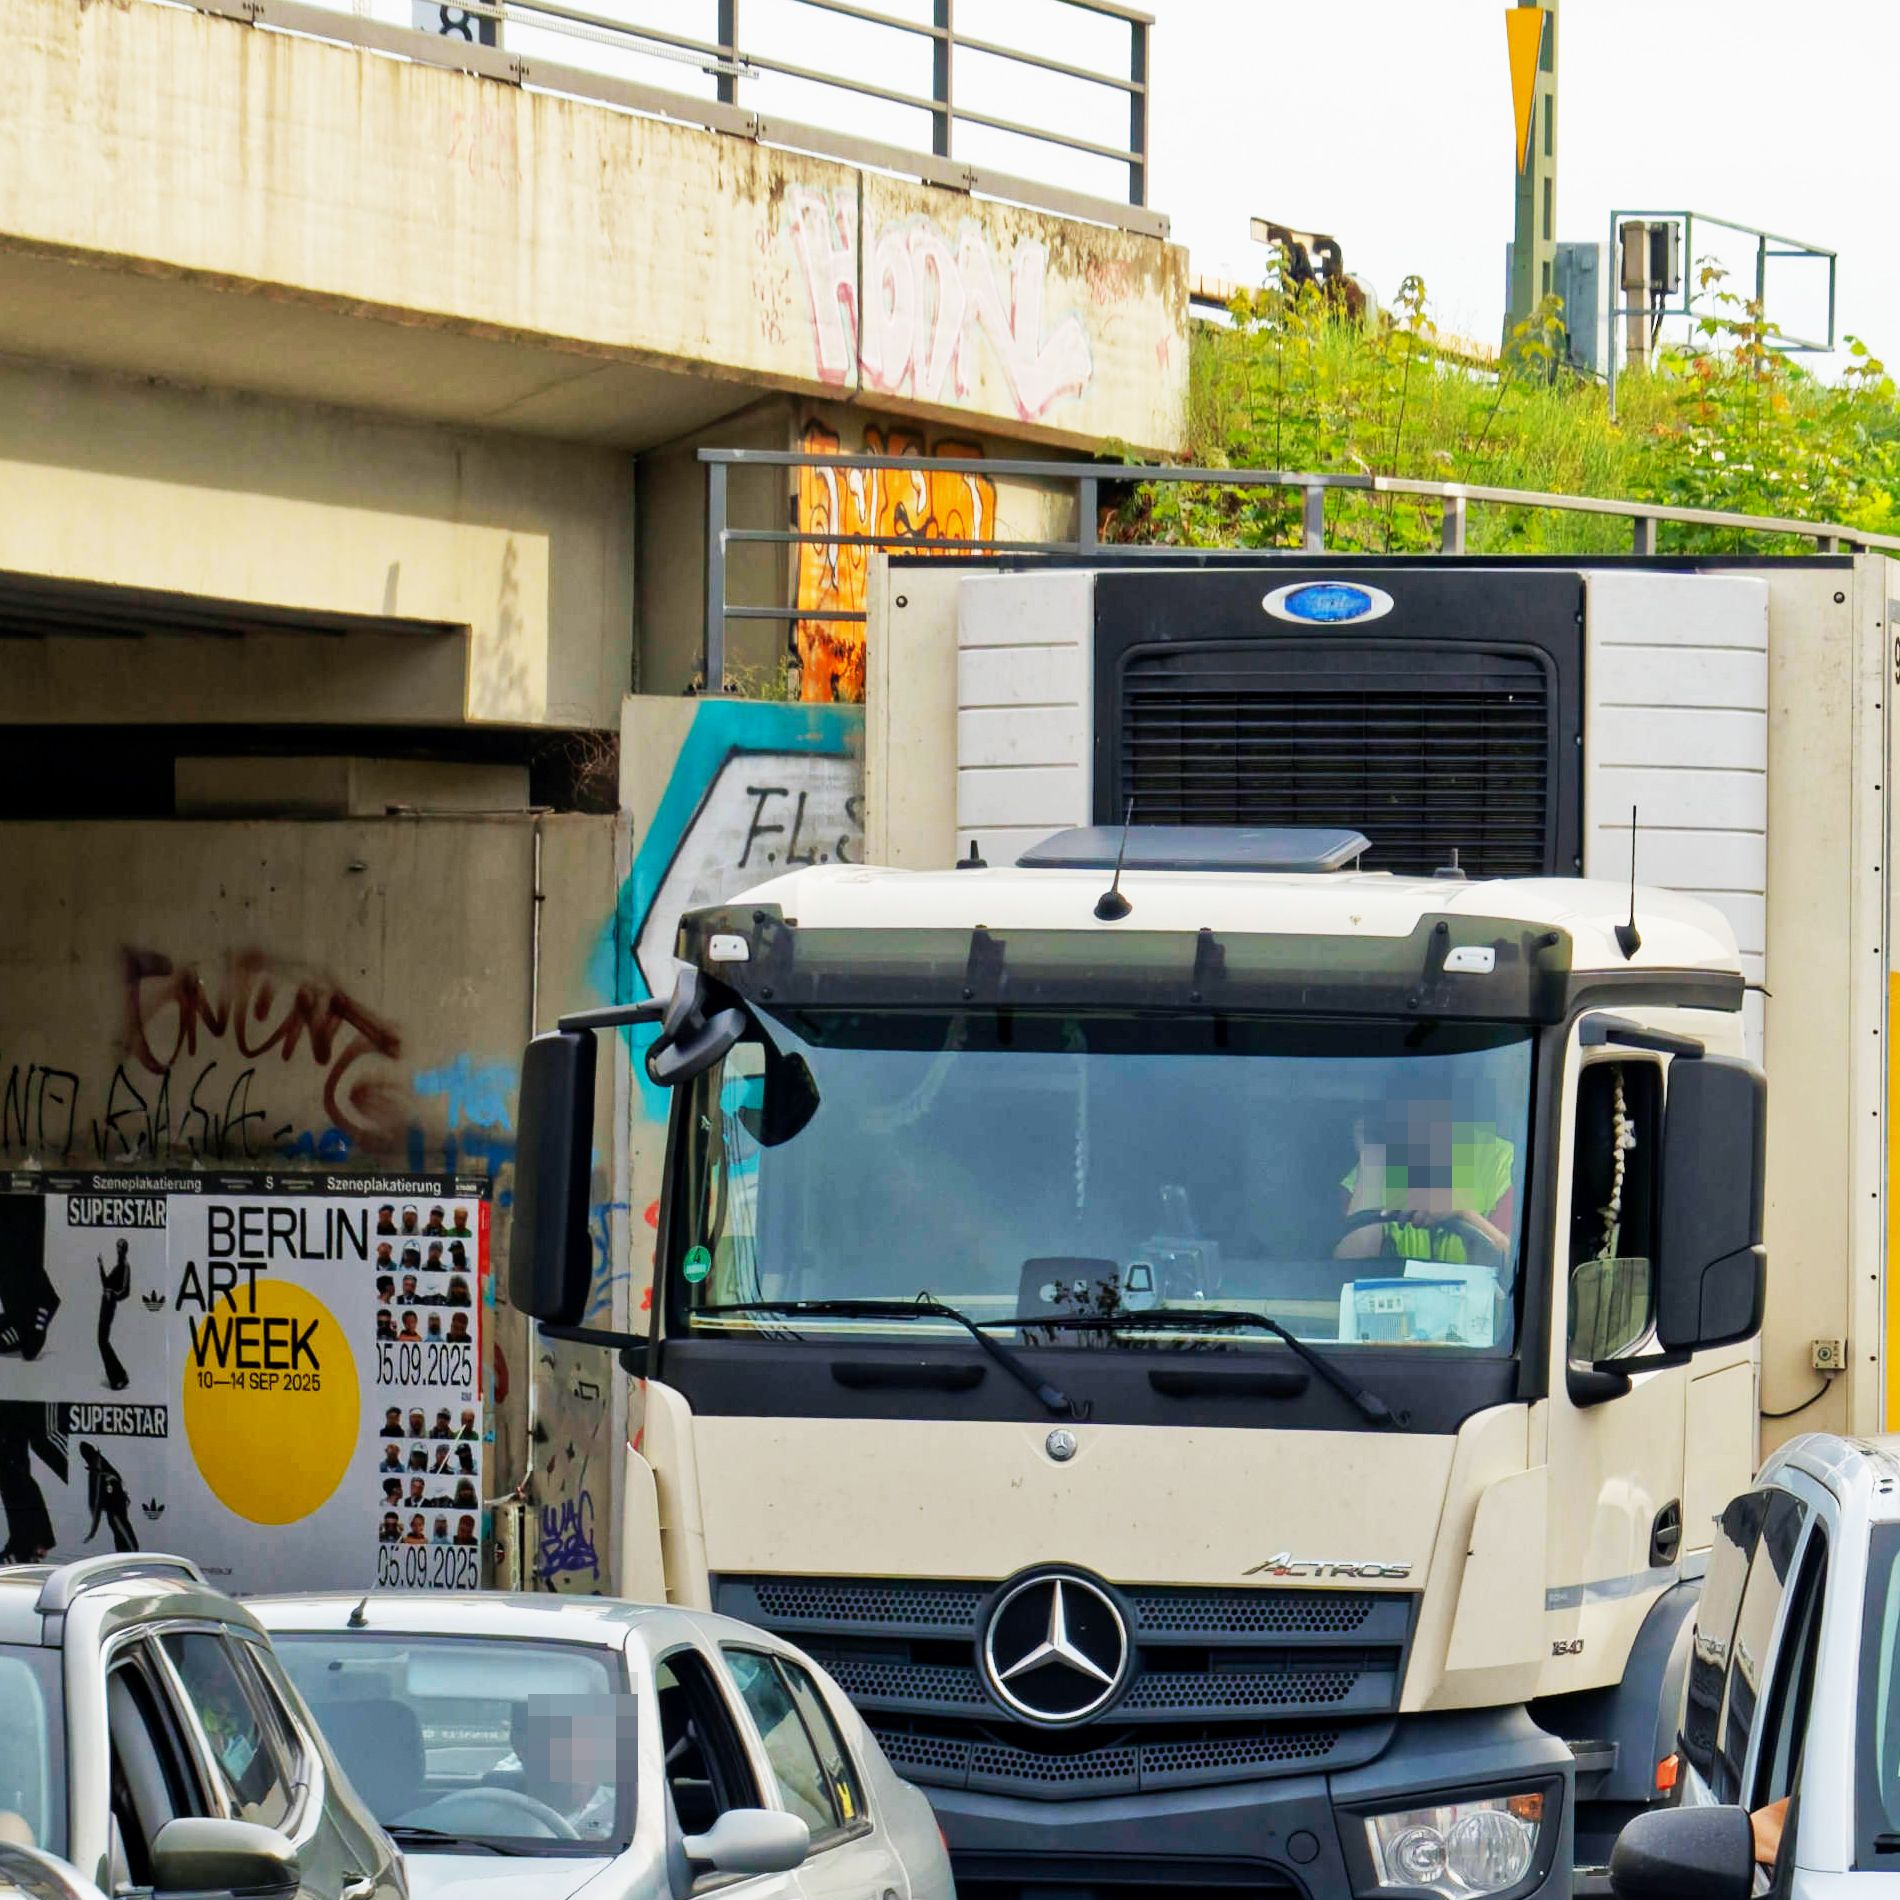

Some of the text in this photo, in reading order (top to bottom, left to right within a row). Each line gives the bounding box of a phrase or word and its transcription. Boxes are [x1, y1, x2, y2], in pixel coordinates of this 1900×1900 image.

[92, 1175, 202, 1193] Szeneplakatierung
[326, 1176, 443, 1196] Szeneplakatierung
[68, 1198, 166, 1226] SUPERSTAR
[208, 1205, 369, 1260] BERLIN
[175, 1261, 267, 1313] ART
[189, 1315, 320, 1370] WEEK
[249, 1372, 279, 1391] SEP
[283, 1374, 321, 1392] 2025
[69, 1405, 166, 1436] SUPERSTAR
[377, 1545, 478, 1589] 05.09.2025
